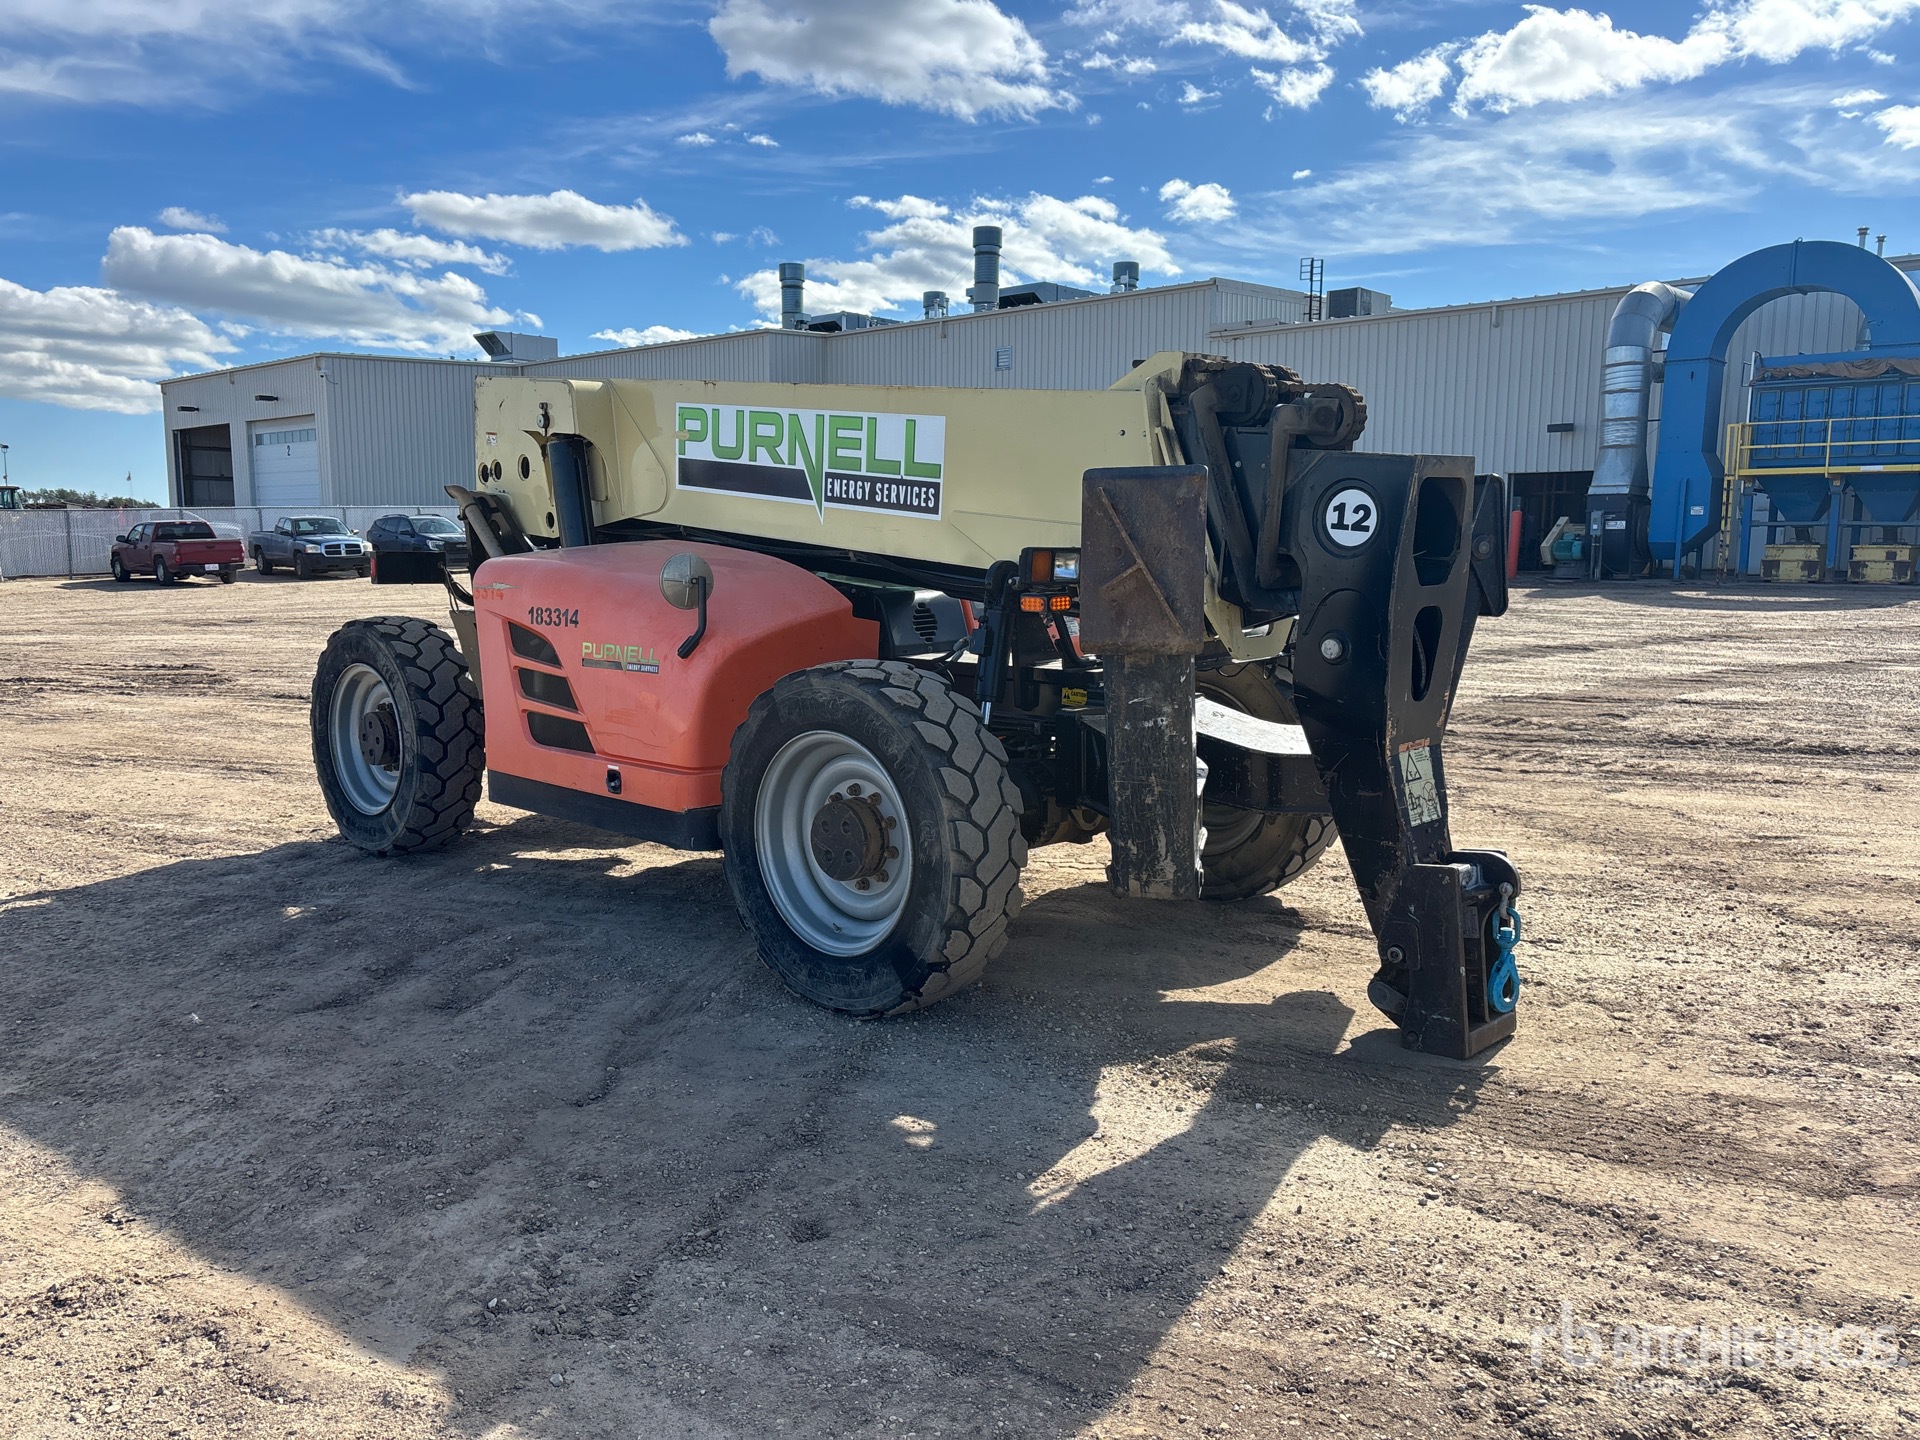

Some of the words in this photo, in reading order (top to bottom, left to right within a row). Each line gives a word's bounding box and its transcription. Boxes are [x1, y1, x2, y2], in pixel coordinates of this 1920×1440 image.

[678, 406, 942, 514] PURNELL
[827, 477, 871, 502] ENERGY
[875, 483, 936, 509] SERVICES
[1329, 501, 1372, 533] 12
[527, 606, 580, 628] 183314
[581, 641, 660, 672] PURNELL
